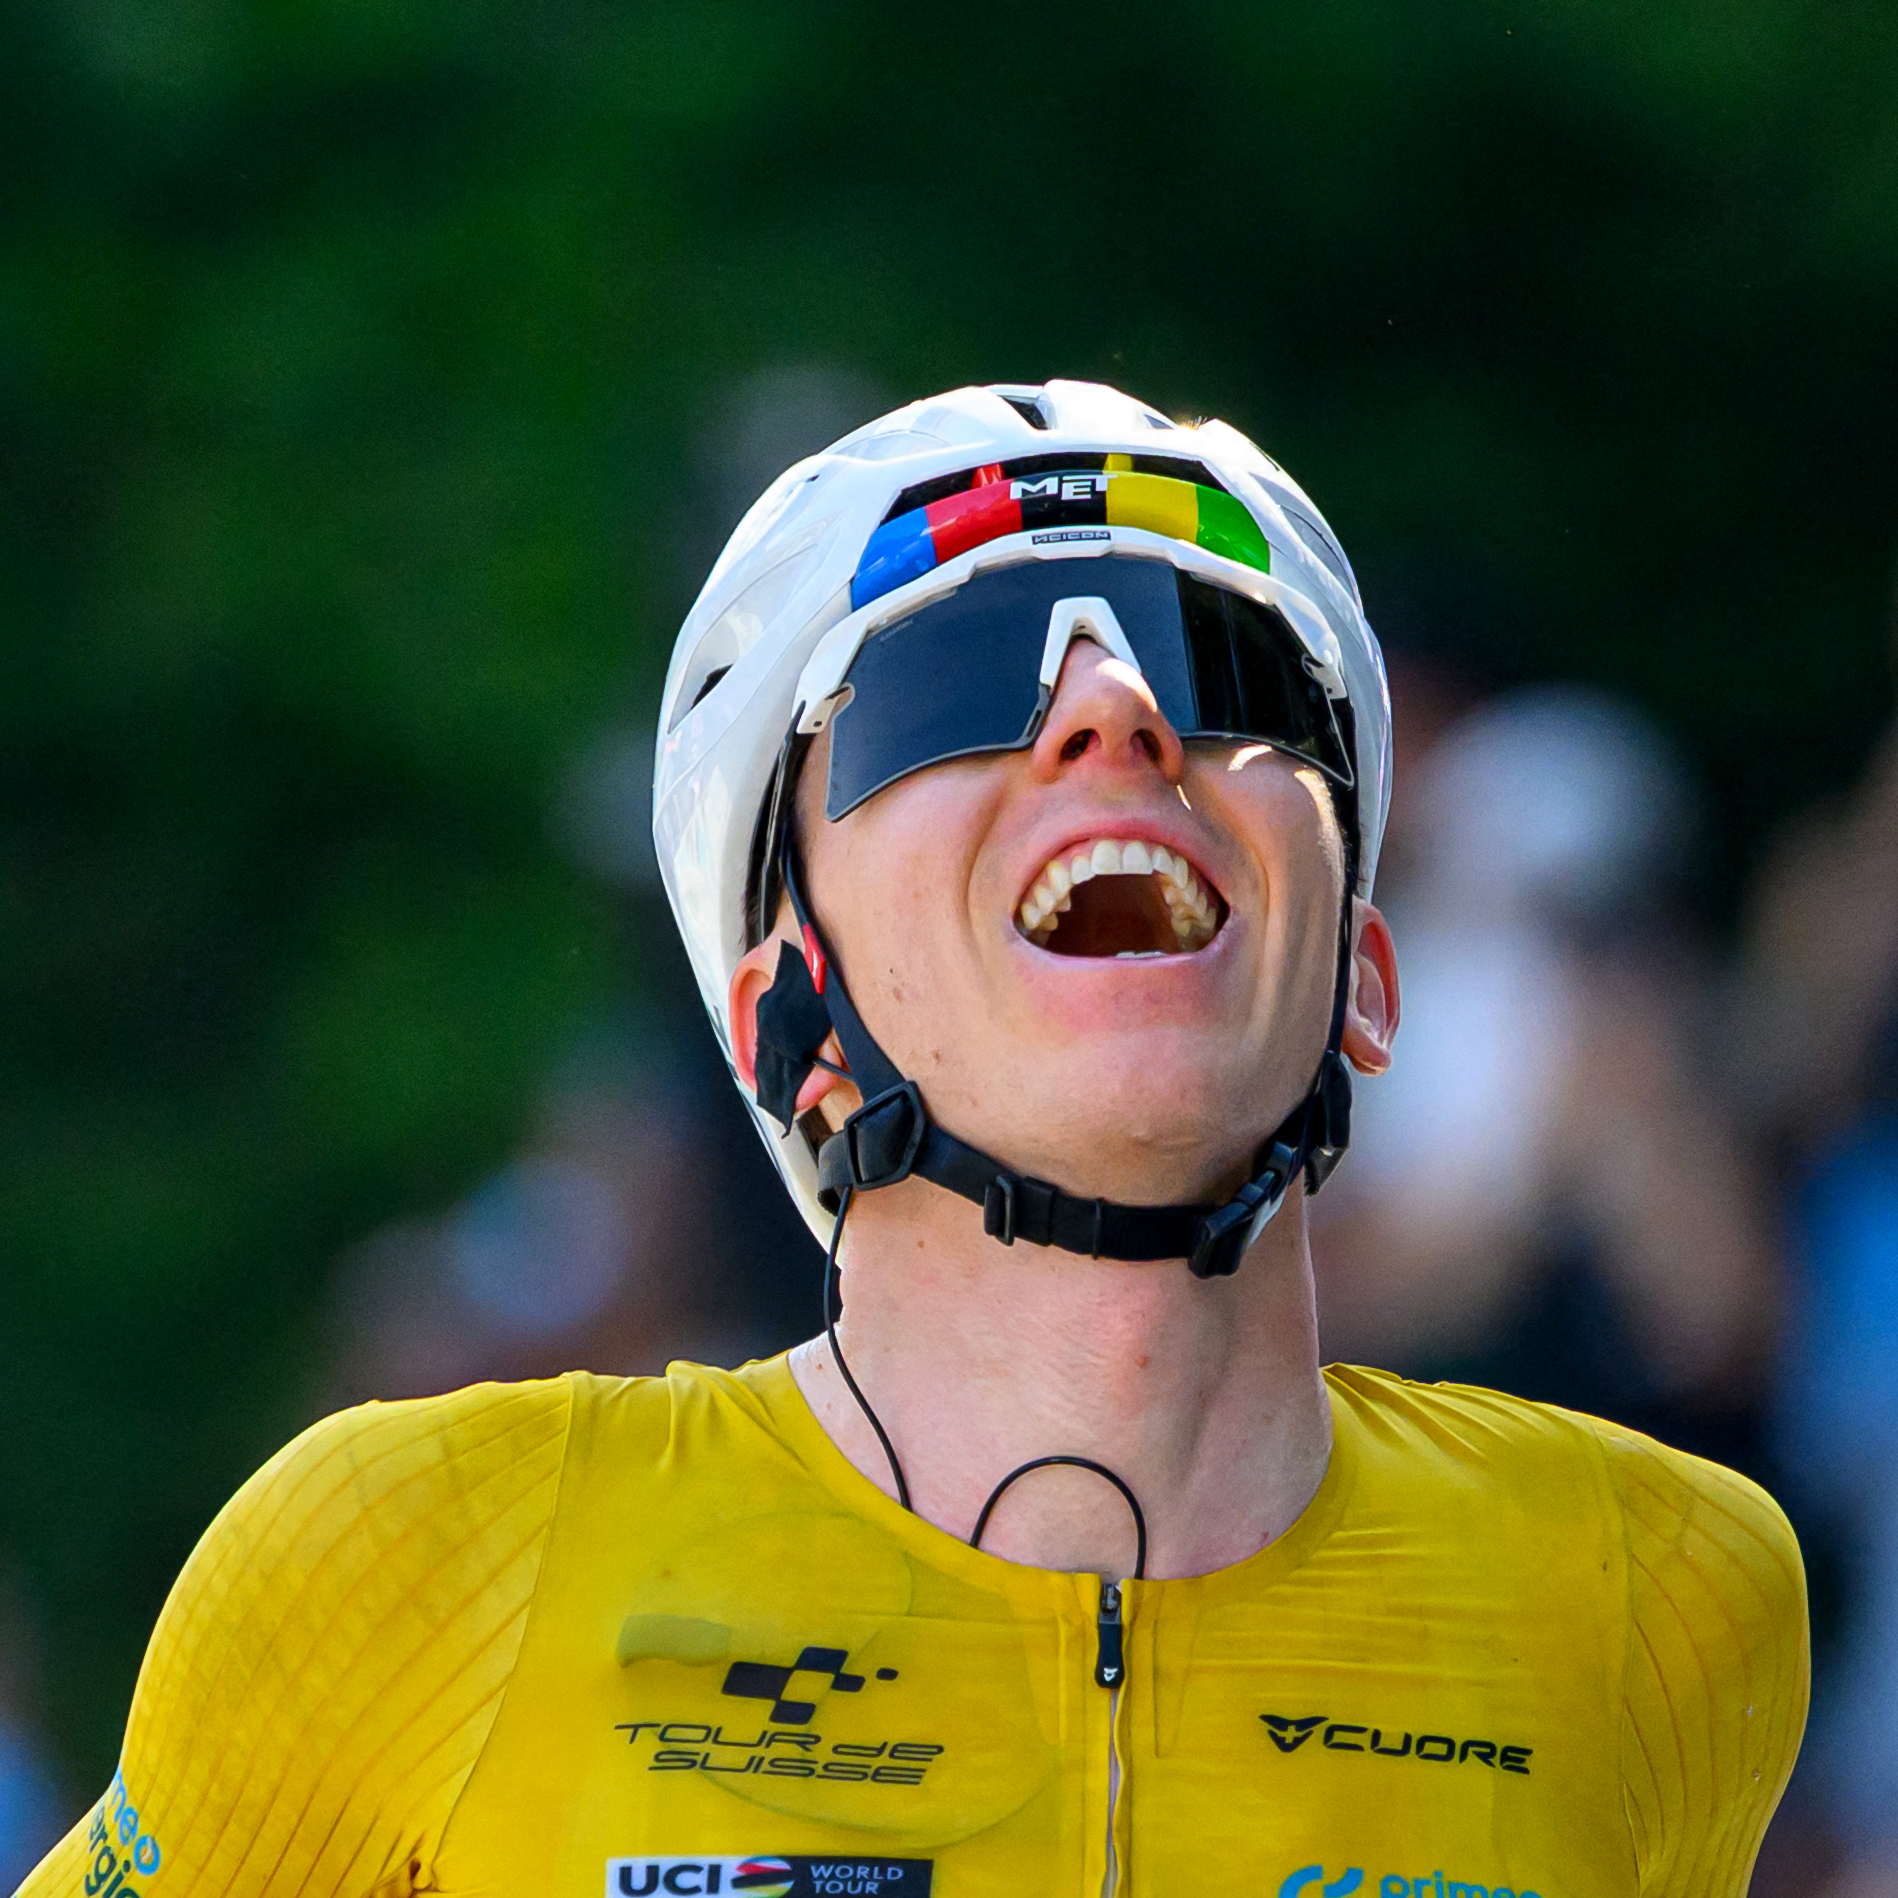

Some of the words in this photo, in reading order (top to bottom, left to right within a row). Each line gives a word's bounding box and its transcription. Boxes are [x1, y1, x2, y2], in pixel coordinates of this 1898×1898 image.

[1010, 474, 1118, 500] MET
[613, 1723, 822, 1753] TOUR
[1323, 1723, 1534, 1775] CUORE
[648, 1749, 928, 1785] SUISSE
[618, 1863, 722, 1898] UCI
[809, 1864, 905, 1881] WORLD
[812, 1880, 880, 1895] TOUR
